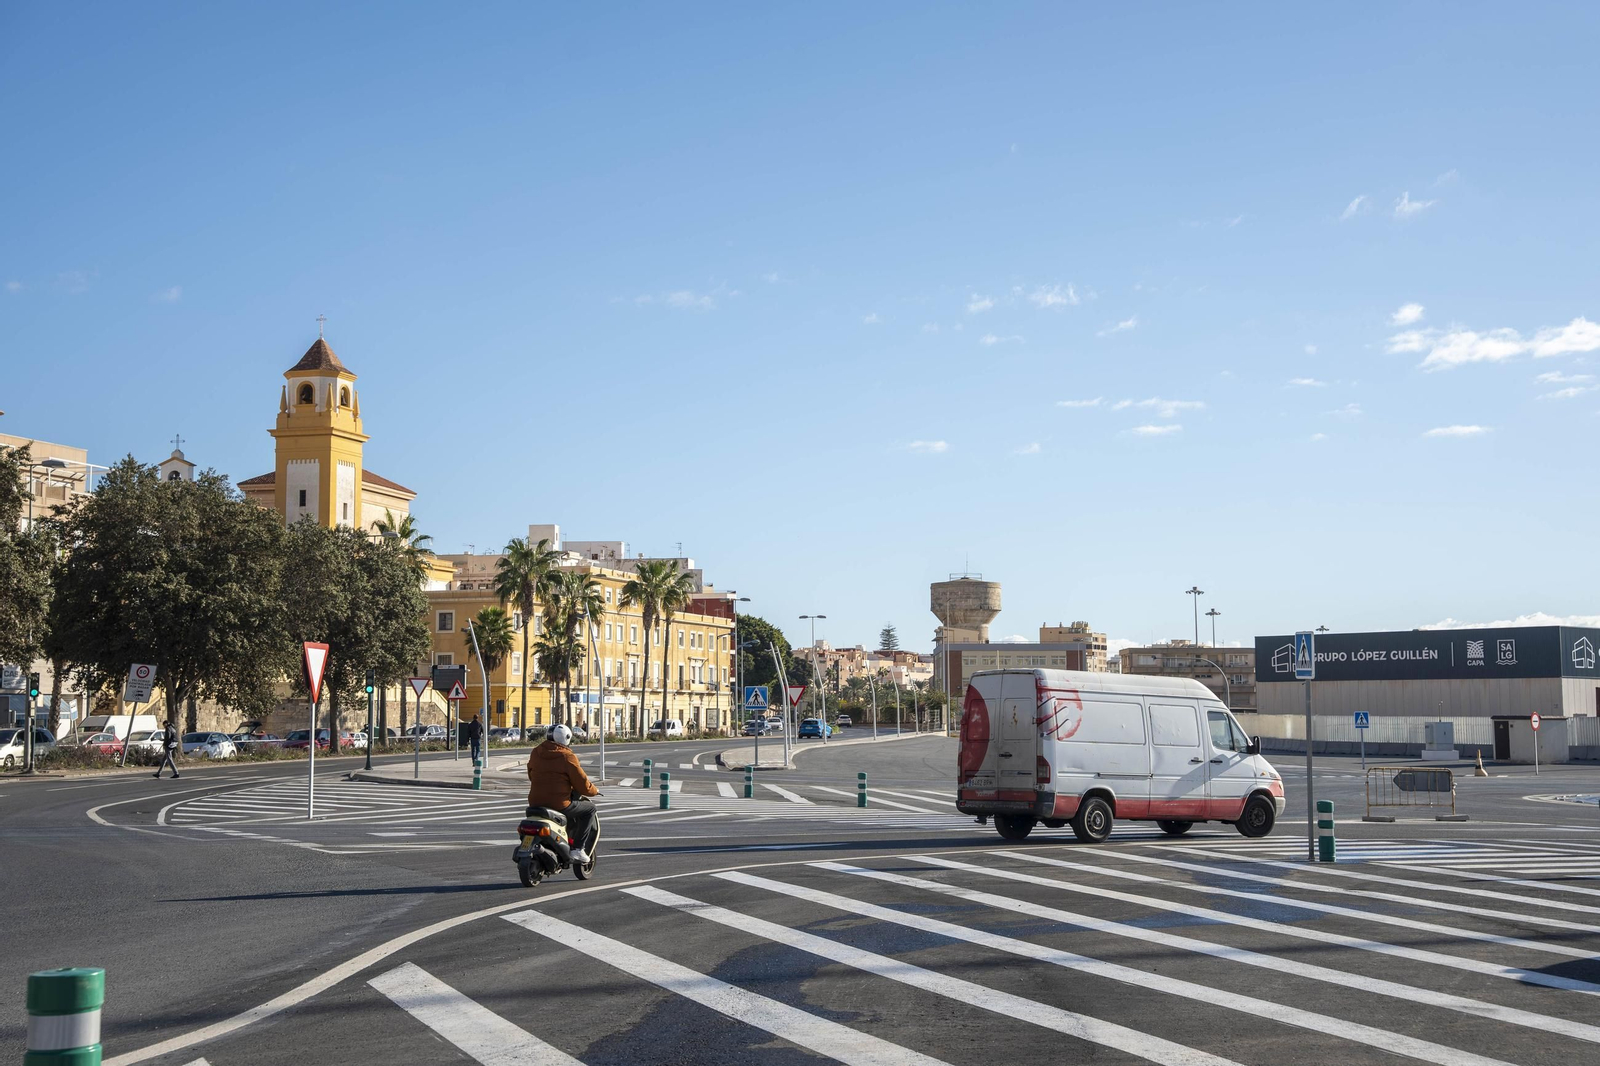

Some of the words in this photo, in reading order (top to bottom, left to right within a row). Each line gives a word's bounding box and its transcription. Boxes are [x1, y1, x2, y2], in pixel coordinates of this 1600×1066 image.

[1500, 643, 1513, 651] SA
[1351, 648, 1387, 661] LÓPEZ
[1390, 646, 1438, 660] GUILLÉN
[1500, 651, 1513, 660] LG
